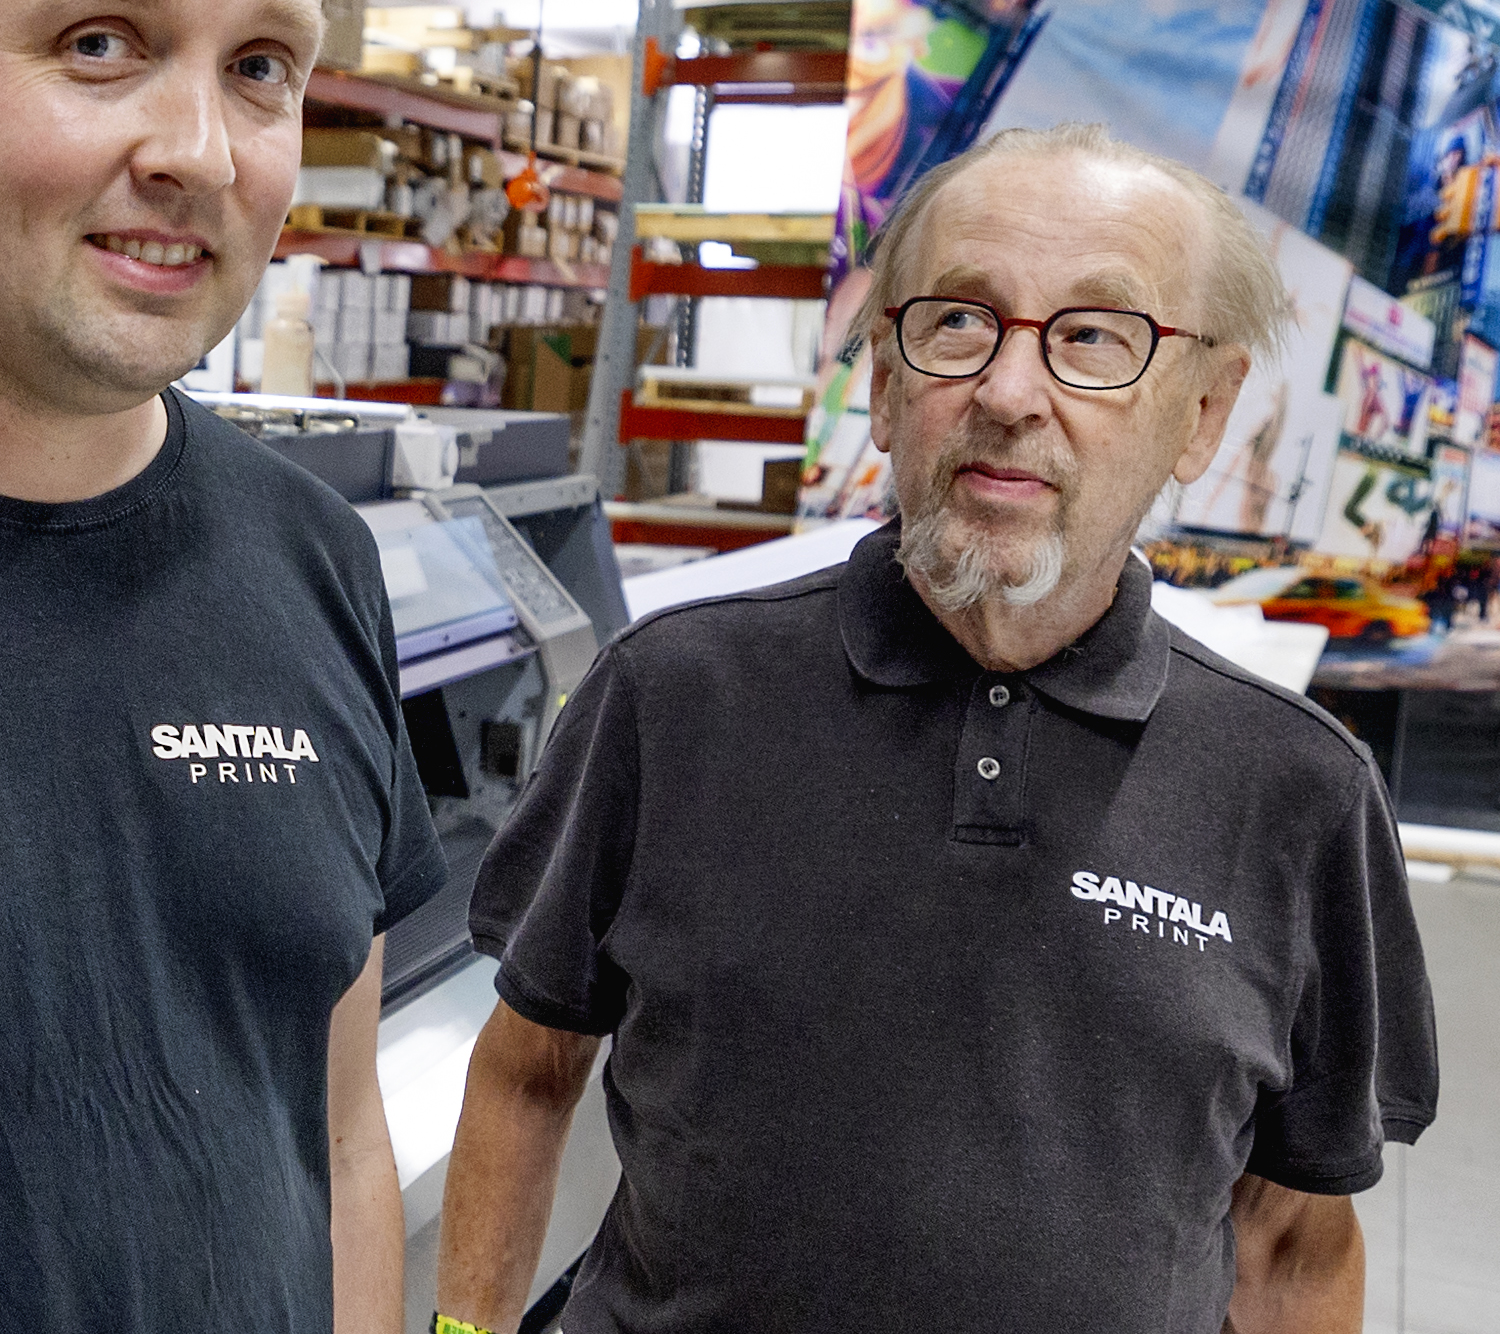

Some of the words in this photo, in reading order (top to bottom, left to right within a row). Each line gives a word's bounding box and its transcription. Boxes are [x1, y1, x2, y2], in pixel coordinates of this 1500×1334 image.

[151, 724, 320, 762] SANTALA
[189, 762, 296, 784] PRINT
[1070, 871, 1233, 943] SANTALA
[1104, 908, 1208, 952] PRINT
